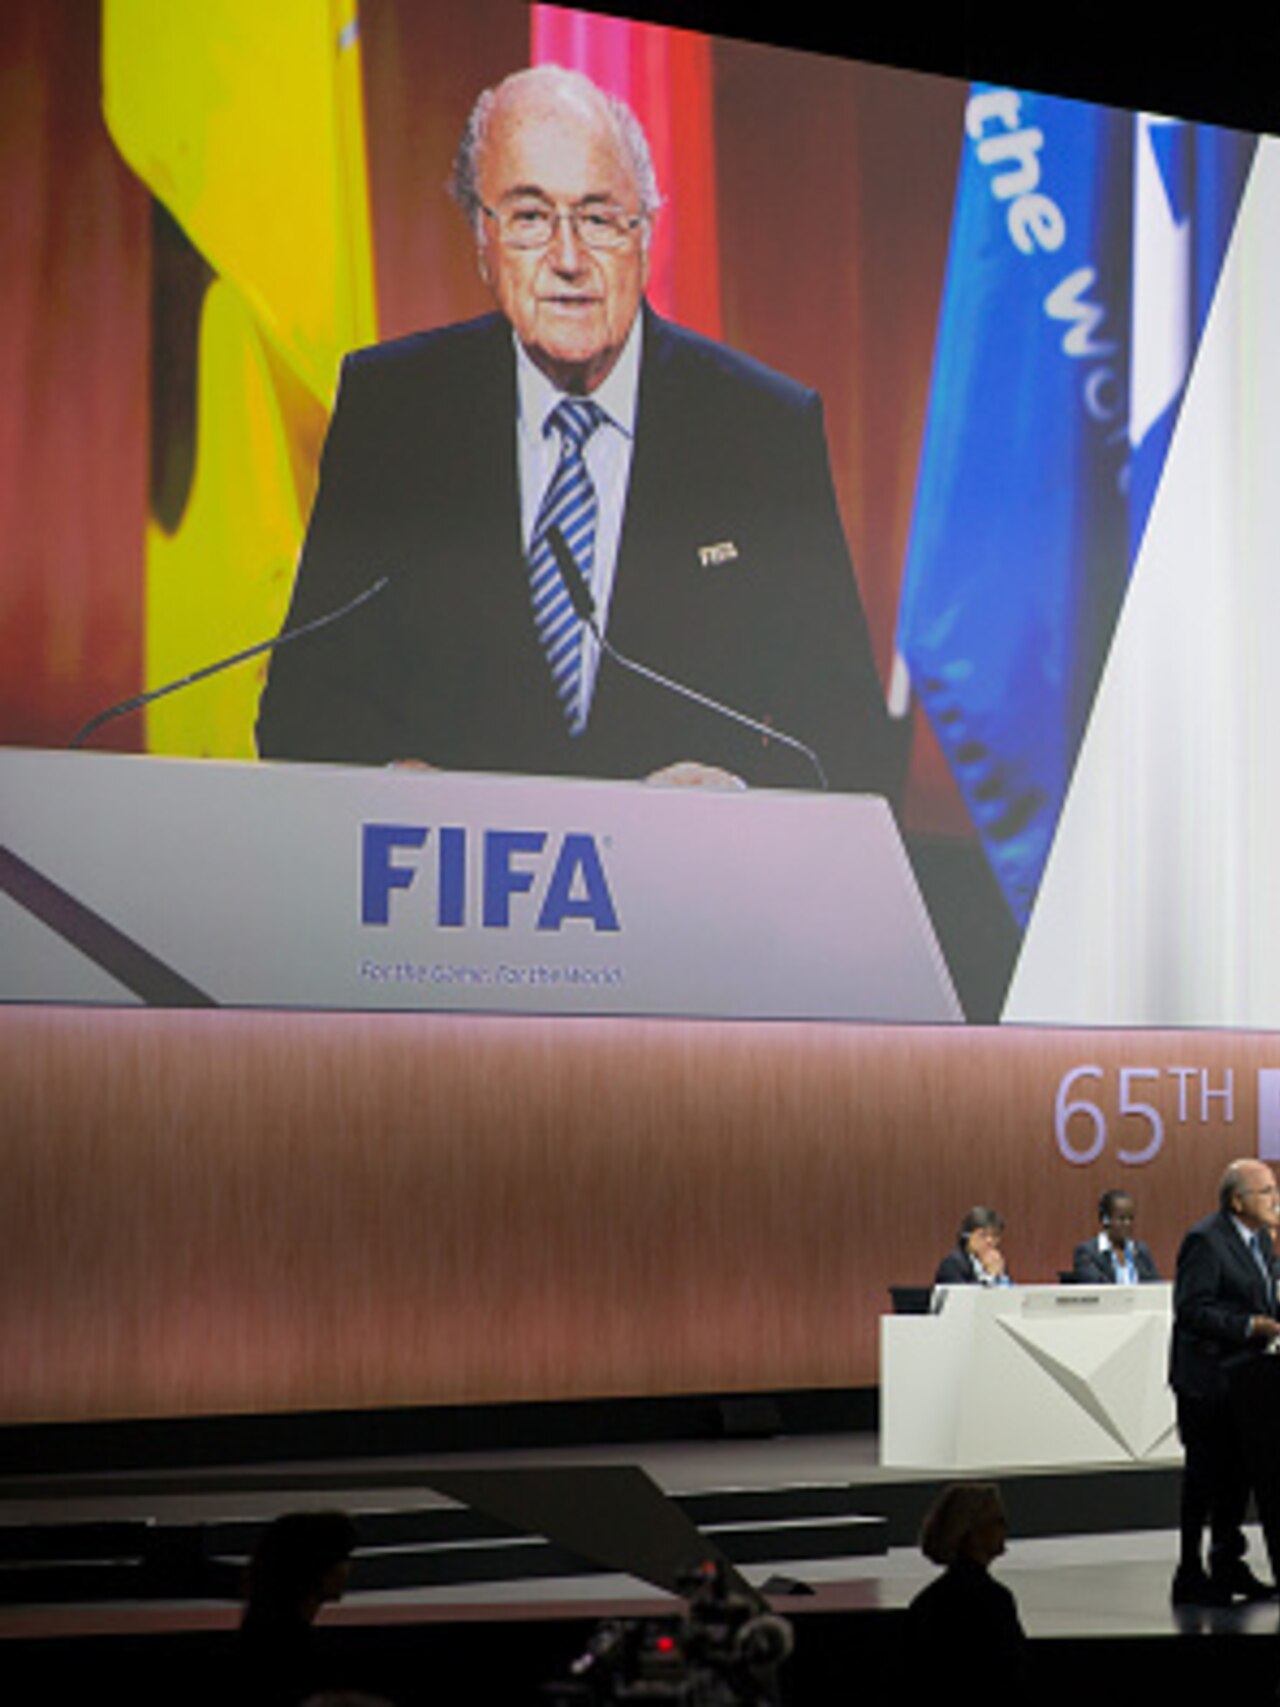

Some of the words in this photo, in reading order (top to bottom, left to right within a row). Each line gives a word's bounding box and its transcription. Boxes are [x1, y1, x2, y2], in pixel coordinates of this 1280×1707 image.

[965, 88, 1067, 256] the
[361, 823, 621, 932] FIFA
[1054, 1065, 1235, 1167] 65TH
